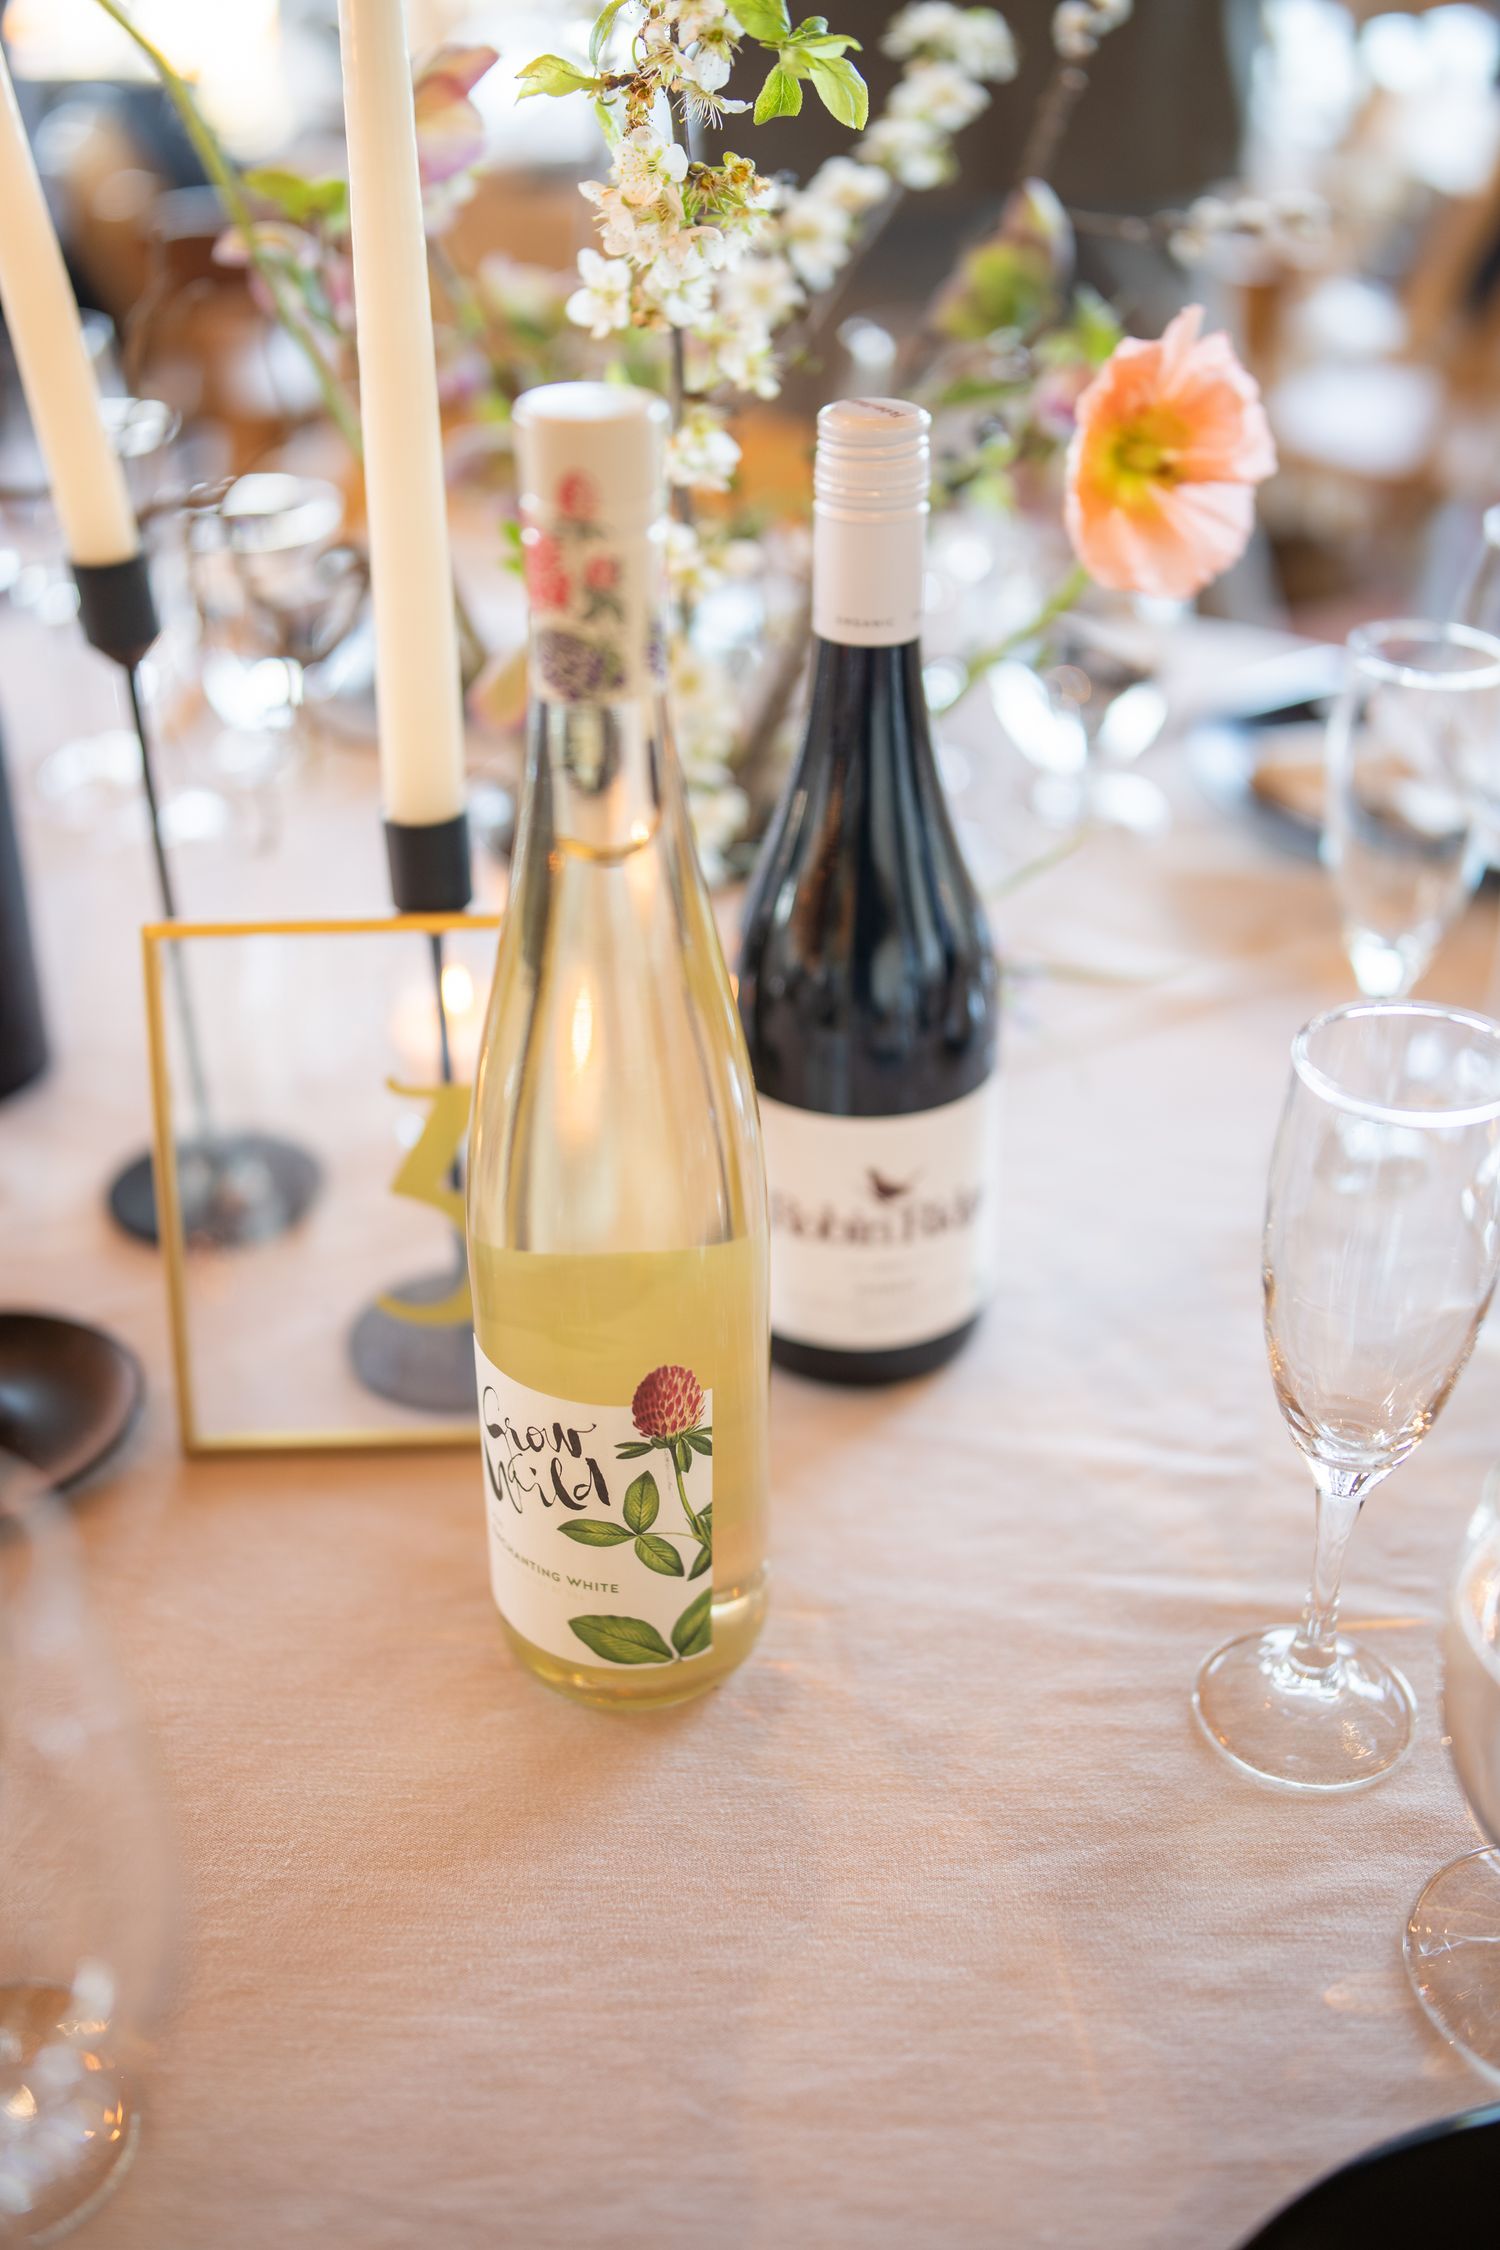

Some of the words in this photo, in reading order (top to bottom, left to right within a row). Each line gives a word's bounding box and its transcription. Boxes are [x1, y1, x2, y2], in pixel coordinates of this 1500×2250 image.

[483, 1385, 597, 1459] Grow
[484, 1440, 611, 1514] Wild
[493, 1522, 561, 1583] CHANTING
[566, 1574, 620, 1594] WHITE
